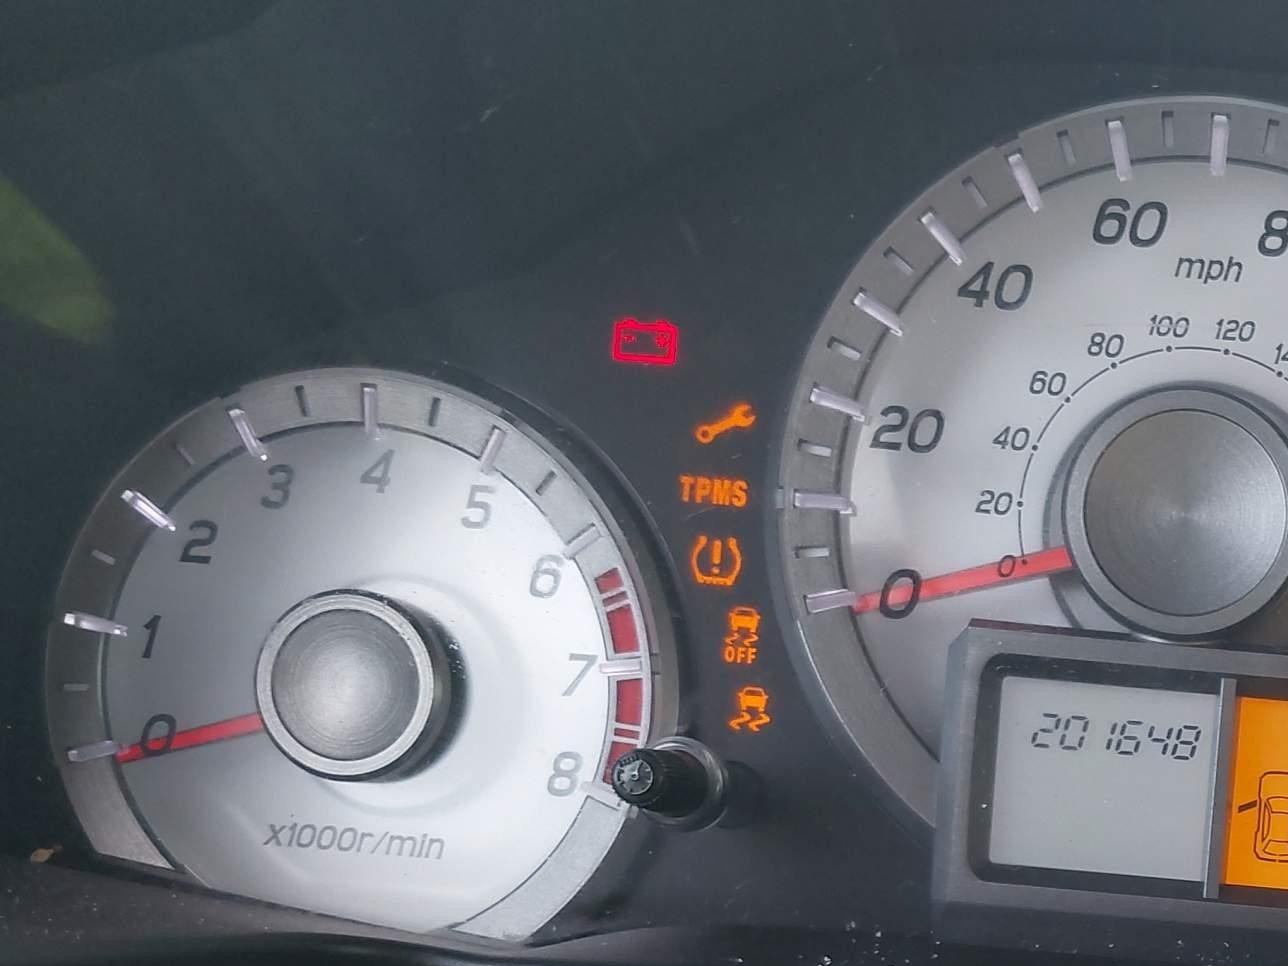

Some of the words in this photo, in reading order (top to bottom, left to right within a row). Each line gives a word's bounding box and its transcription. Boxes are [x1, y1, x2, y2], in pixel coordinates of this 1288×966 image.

[1092, 198, 1169, 248] 60
[957, 261, 1034, 311] 40
[1173, 255, 1243, 287] mph
[1087, 333, 1125, 358] 80
[1149, 316, 1190, 339] 100
[1215, 319, 1256, 343] 120
[1029, 372, 1067, 397] 60
[870, 405, 945, 454] 20
[992, 427, 1030, 452] 40
[260, 463, 294, 510] 3
[360, 449, 395, 493] 4
[679, 474, 748, 507] TPMS
[461, 485, 496, 530] 5
[975, 491, 1013, 516] 20
[180, 520, 219, 565] 2
[529, 554, 563, 599] 6
[999, 554, 1017, 579] 0
[880, 569, 923, 620] 0
[141, 615, 163, 659] 1
[724, 647, 757, 665] OFF
[561, 654, 597, 697] 7
[140, 714, 176, 757] 0
[1031, 713, 1201, 760] 201648
[547, 752, 582, 797] 8
[262, 822, 445, 861] x1000r/min
